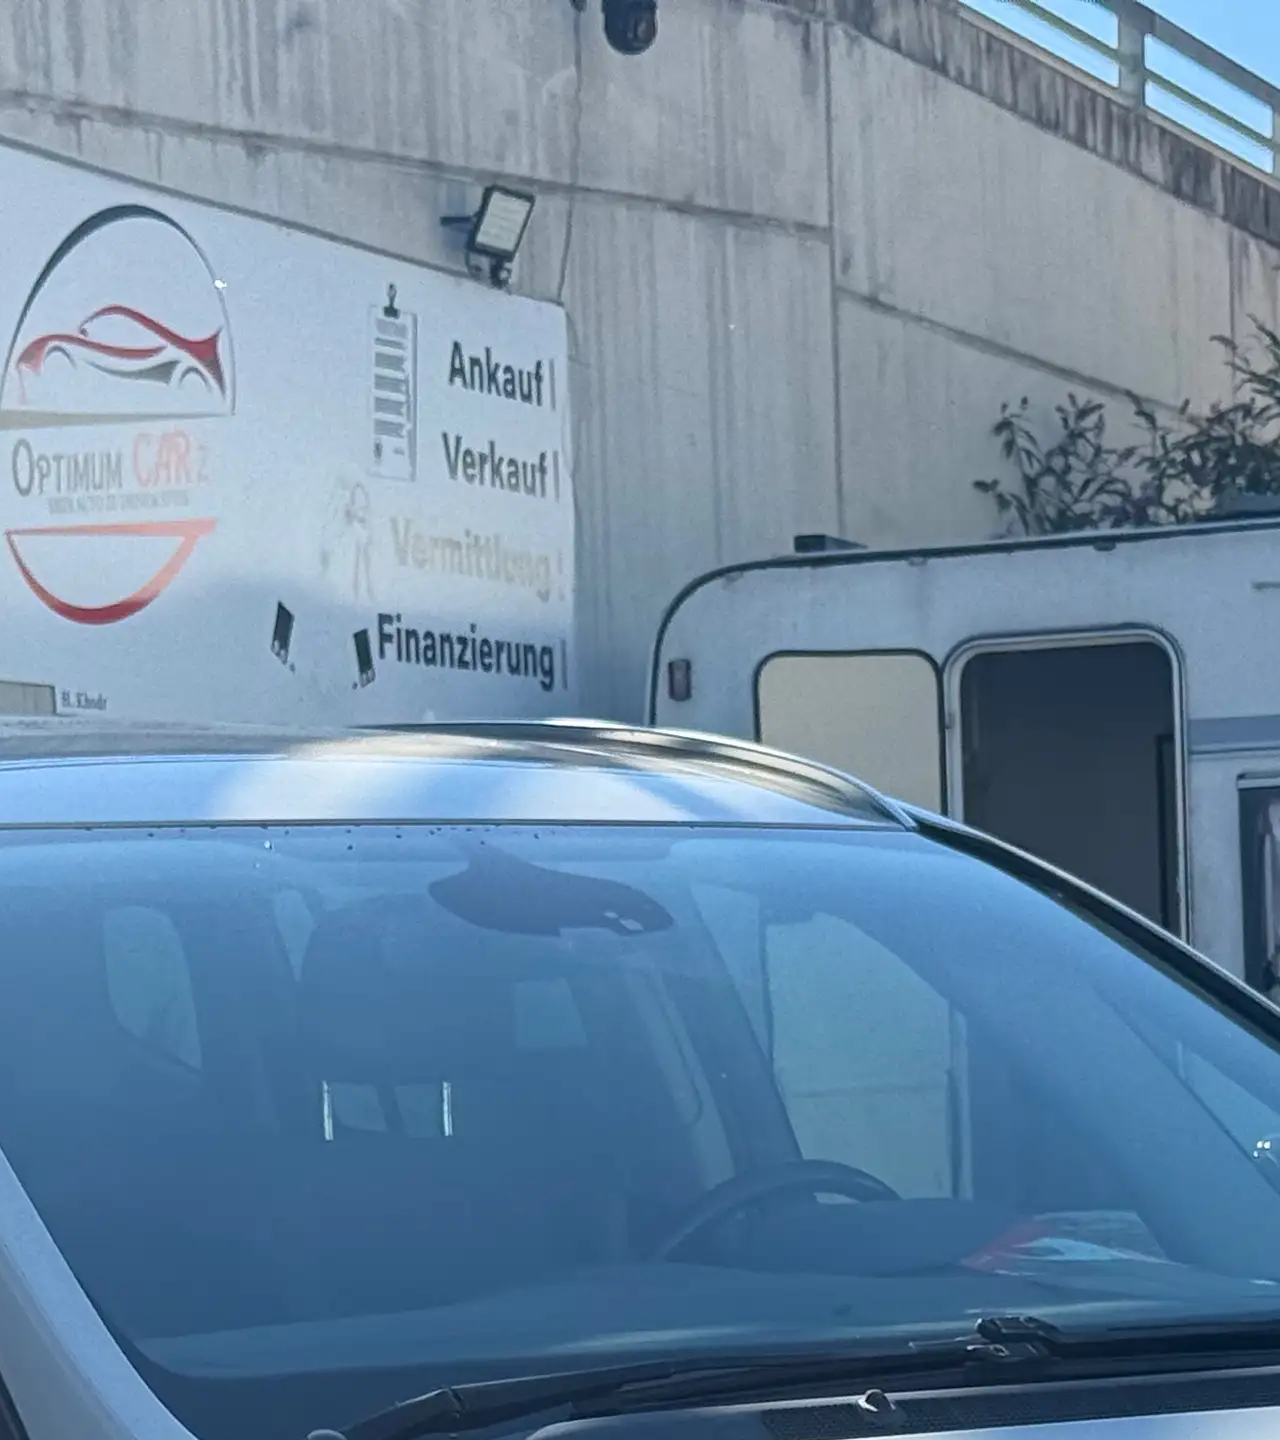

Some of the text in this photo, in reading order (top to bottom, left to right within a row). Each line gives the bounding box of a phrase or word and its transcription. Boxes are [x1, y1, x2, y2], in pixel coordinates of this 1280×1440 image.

[448, 340, 544, 407] Ankauf
[441, 431, 547, 499] Verkauf
[376, 612, 555, 692] Finanzierung
